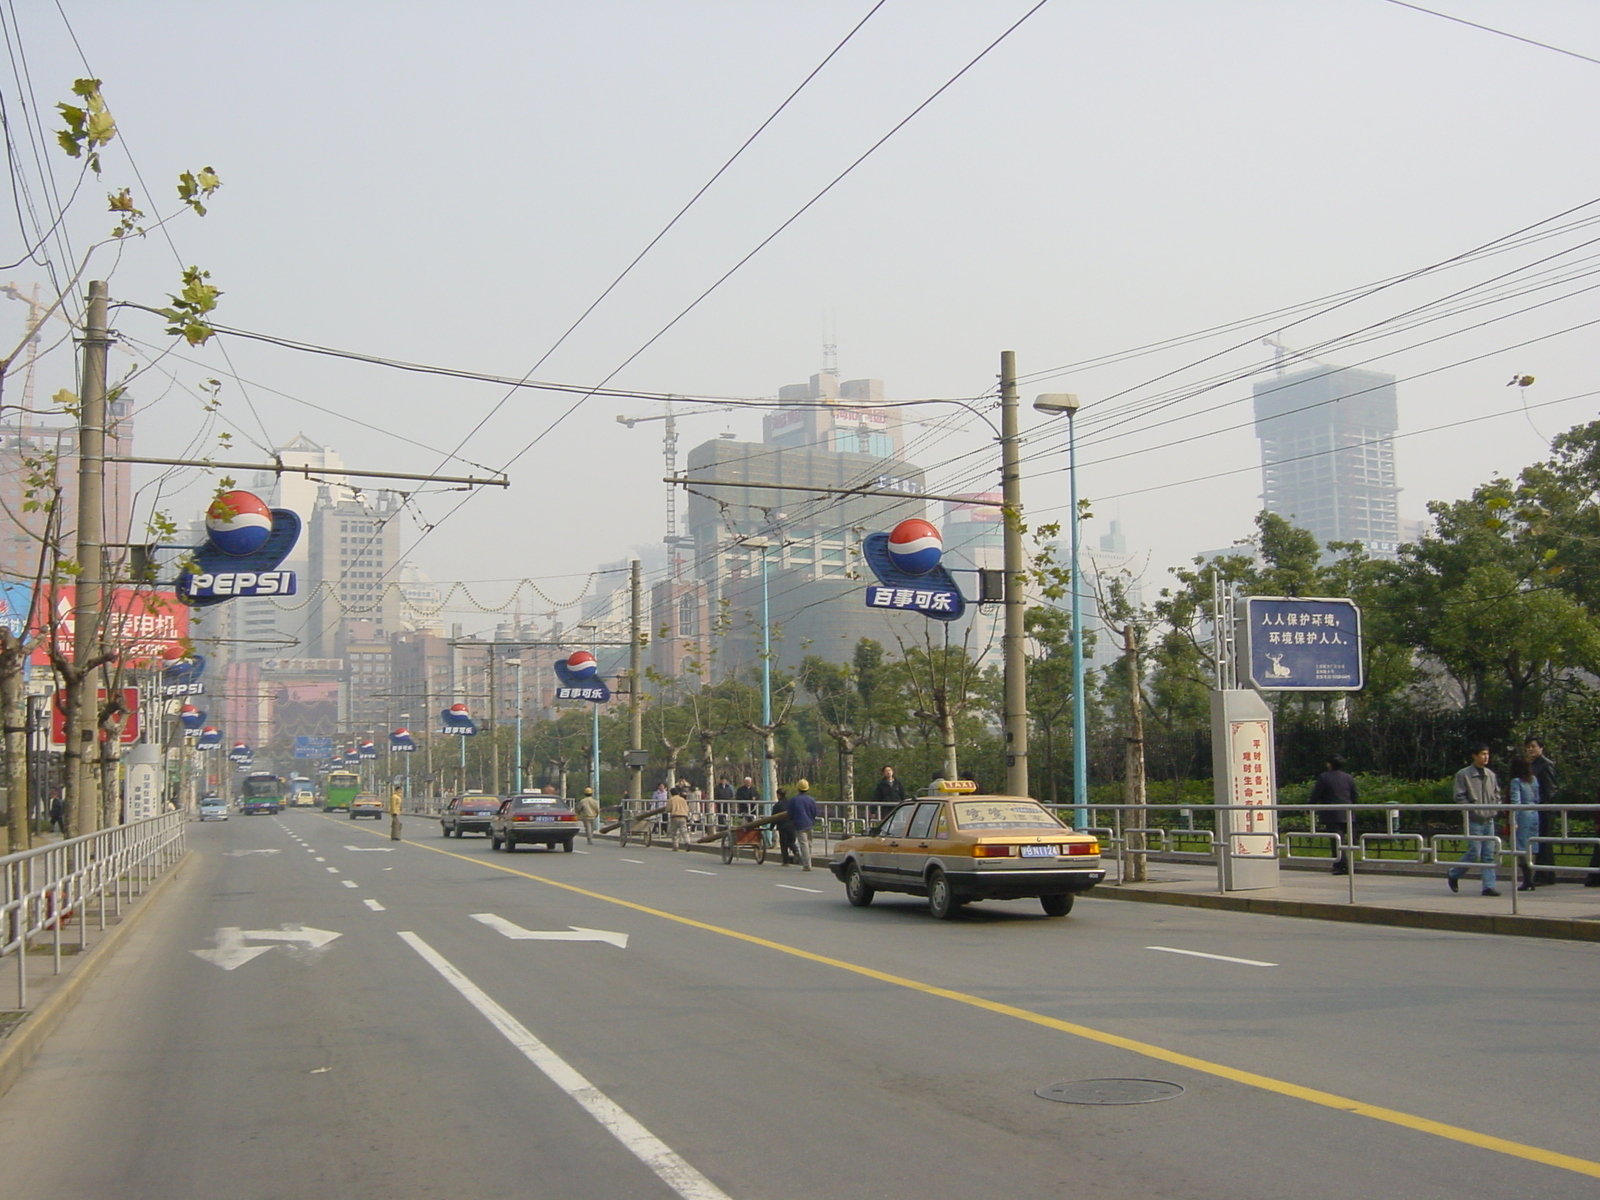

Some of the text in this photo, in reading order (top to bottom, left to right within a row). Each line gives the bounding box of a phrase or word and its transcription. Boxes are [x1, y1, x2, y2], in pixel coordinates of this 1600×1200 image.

[189, 572, 291, 596] PEPSI
[873, 588, 952, 611] 百事可乐
[98, 613, 178, 638] 菱电机
[559, 688, 603, 699] 百事可乐
